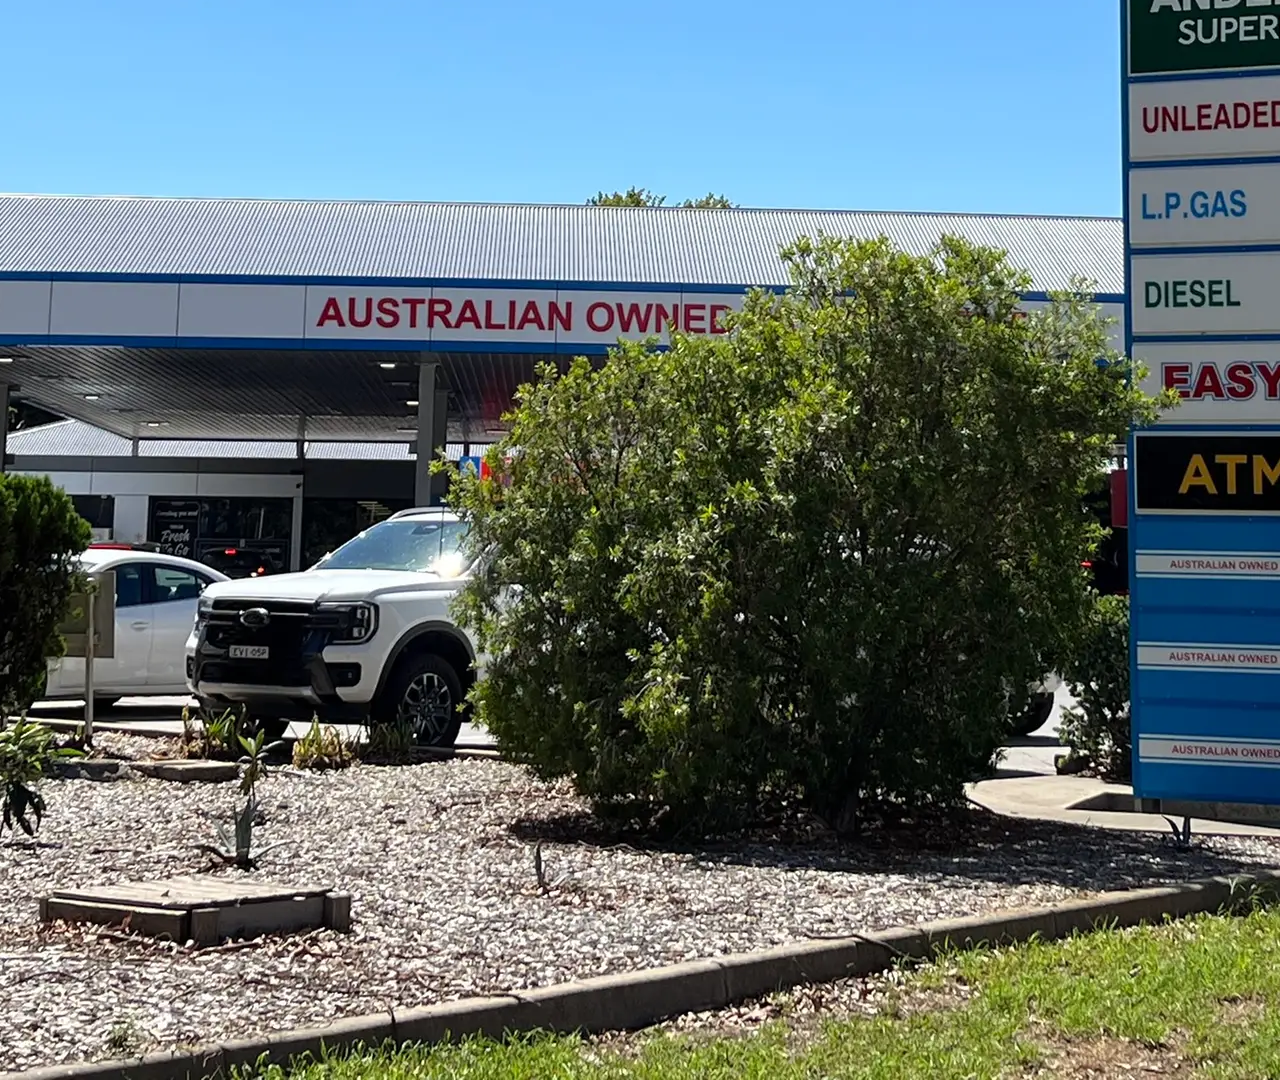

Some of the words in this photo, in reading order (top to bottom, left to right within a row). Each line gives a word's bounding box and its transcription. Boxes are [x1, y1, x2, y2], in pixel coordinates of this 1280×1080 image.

[1141, 189, 1248, 220] L.P.GAS
[1144, 279, 1241, 309] DIESEL
[316, 296, 573, 331] AUSTRALIAN
[585, 300, 734, 335] OWNED
[161, 528, 191, 542] Fresh
[174, 542, 190, 556] Go
[1170, 559, 1236, 570] AUSTRALIAN
[1238, 560, 1279, 572] OWNED
[1169, 651, 1236, 663] AUSTRALIAN
[1237, 653, 1279, 665] OWNED
[1171, 744, 1239, 757] AUSTRALIAN
